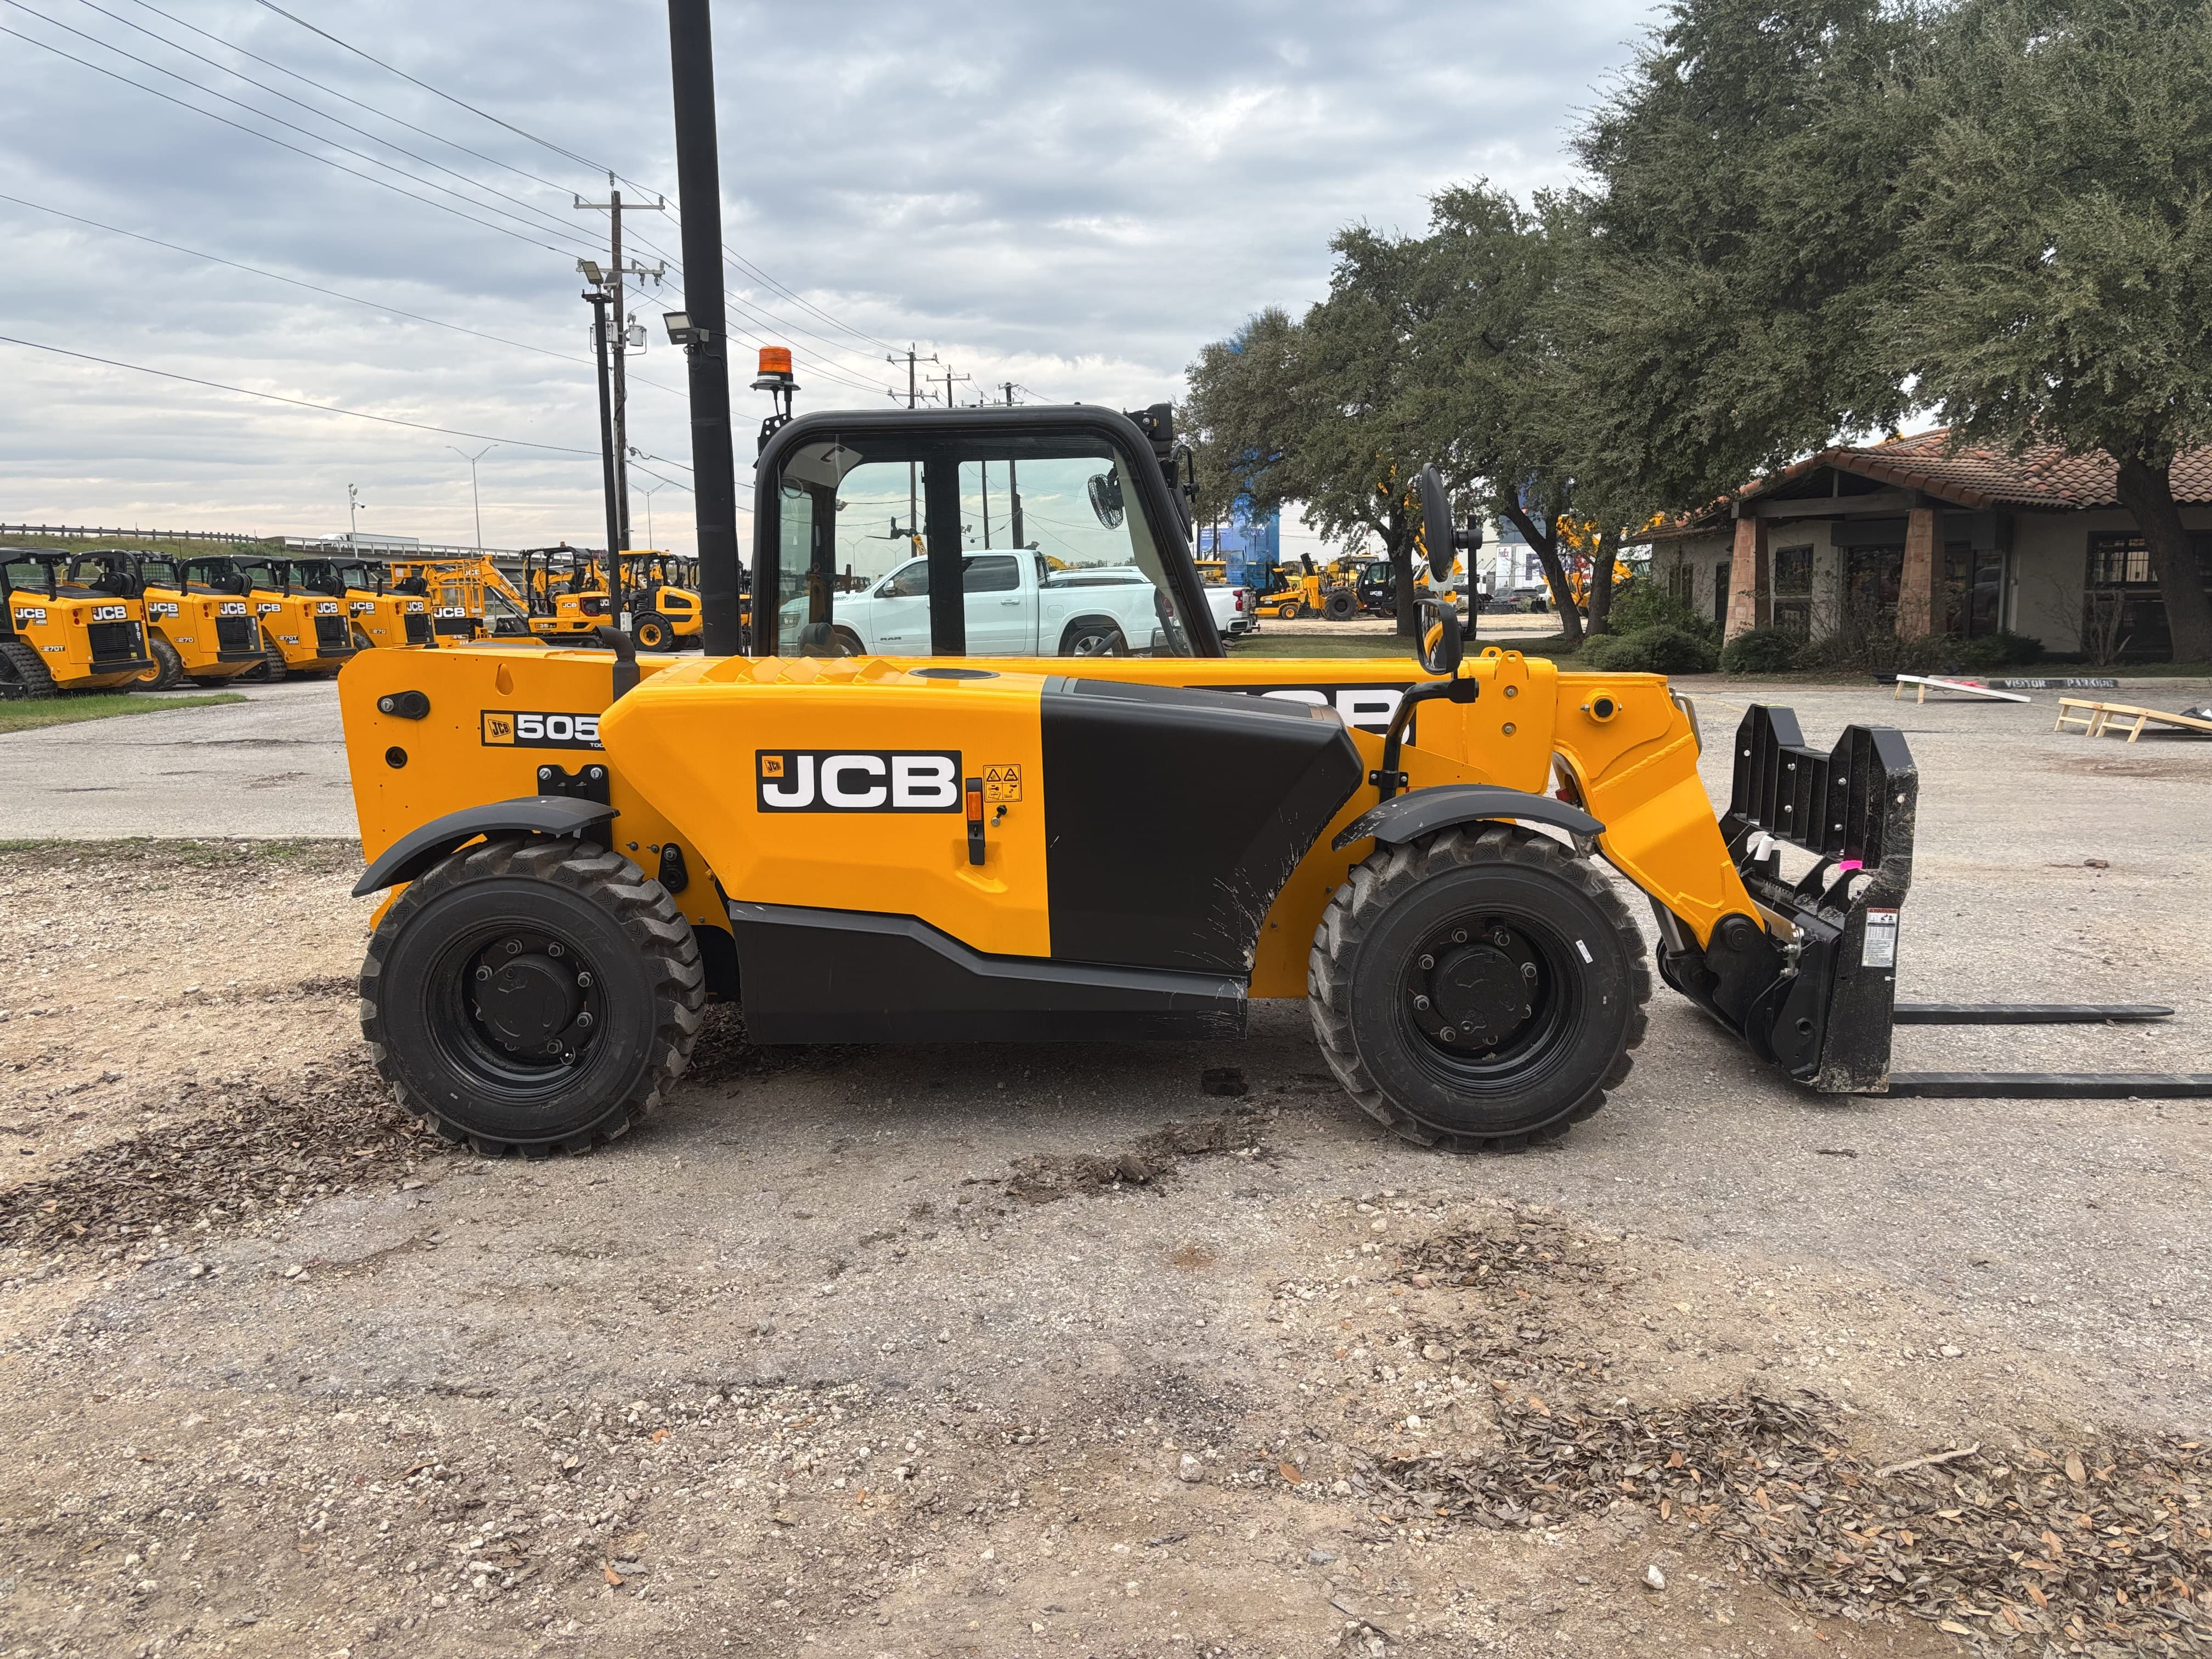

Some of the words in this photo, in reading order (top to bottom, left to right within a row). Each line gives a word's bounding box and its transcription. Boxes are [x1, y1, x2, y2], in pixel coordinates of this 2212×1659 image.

[1498, 549, 1509, 558] FedEx
[149, 603, 178, 612] JCB
[220, 603, 247, 614] JCB
[257, 603, 281, 612] JCB
[317, 602, 338, 613] JCB
[407, 602, 424, 612] JCB
[15, 608, 46, 618] JCB
[93, 606, 127, 620] JCB
[433, 607, 466, 618] JCB
[2005, 679, 2046, 688] VISITOR
[492, 721, 509, 736] JCB
[517, 714, 601, 741] 505
[768, 761, 780, 771] JCB
[763, 755, 957, 808] JCB
